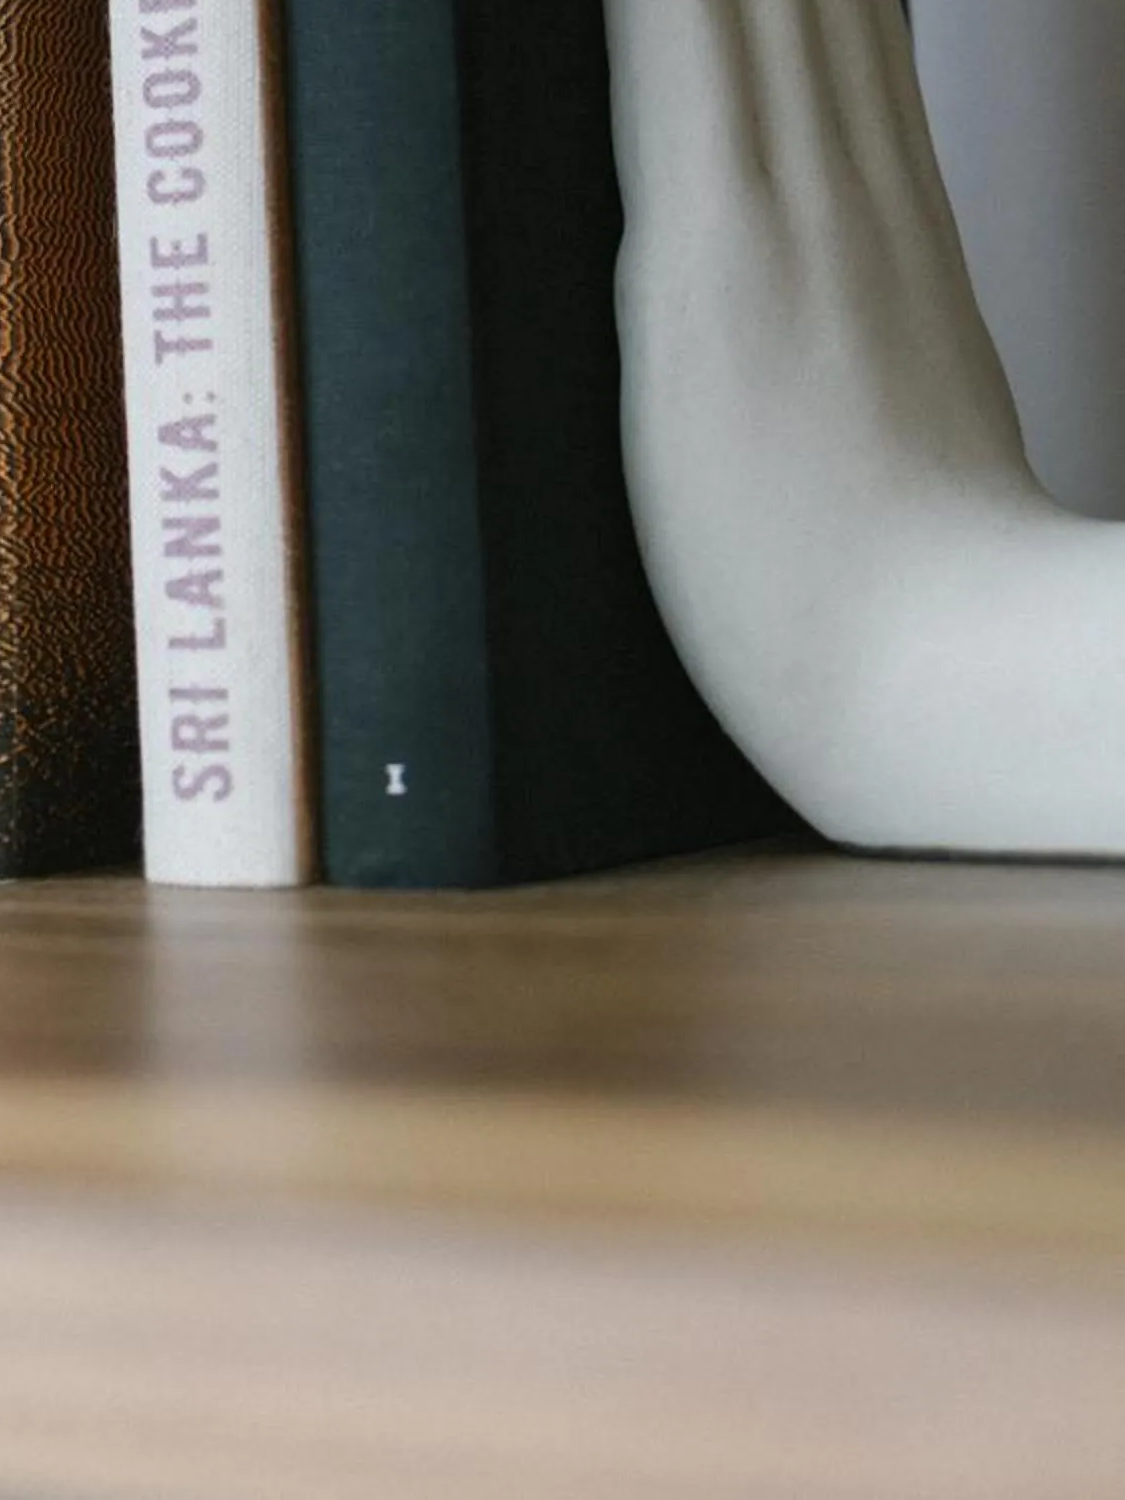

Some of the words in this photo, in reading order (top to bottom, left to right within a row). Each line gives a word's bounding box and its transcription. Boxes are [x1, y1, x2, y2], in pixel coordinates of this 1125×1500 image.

[150, 231, 213, 365] THE
[157, 389, 227, 652] LANKA:
[169, 685, 233, 802] SRI
